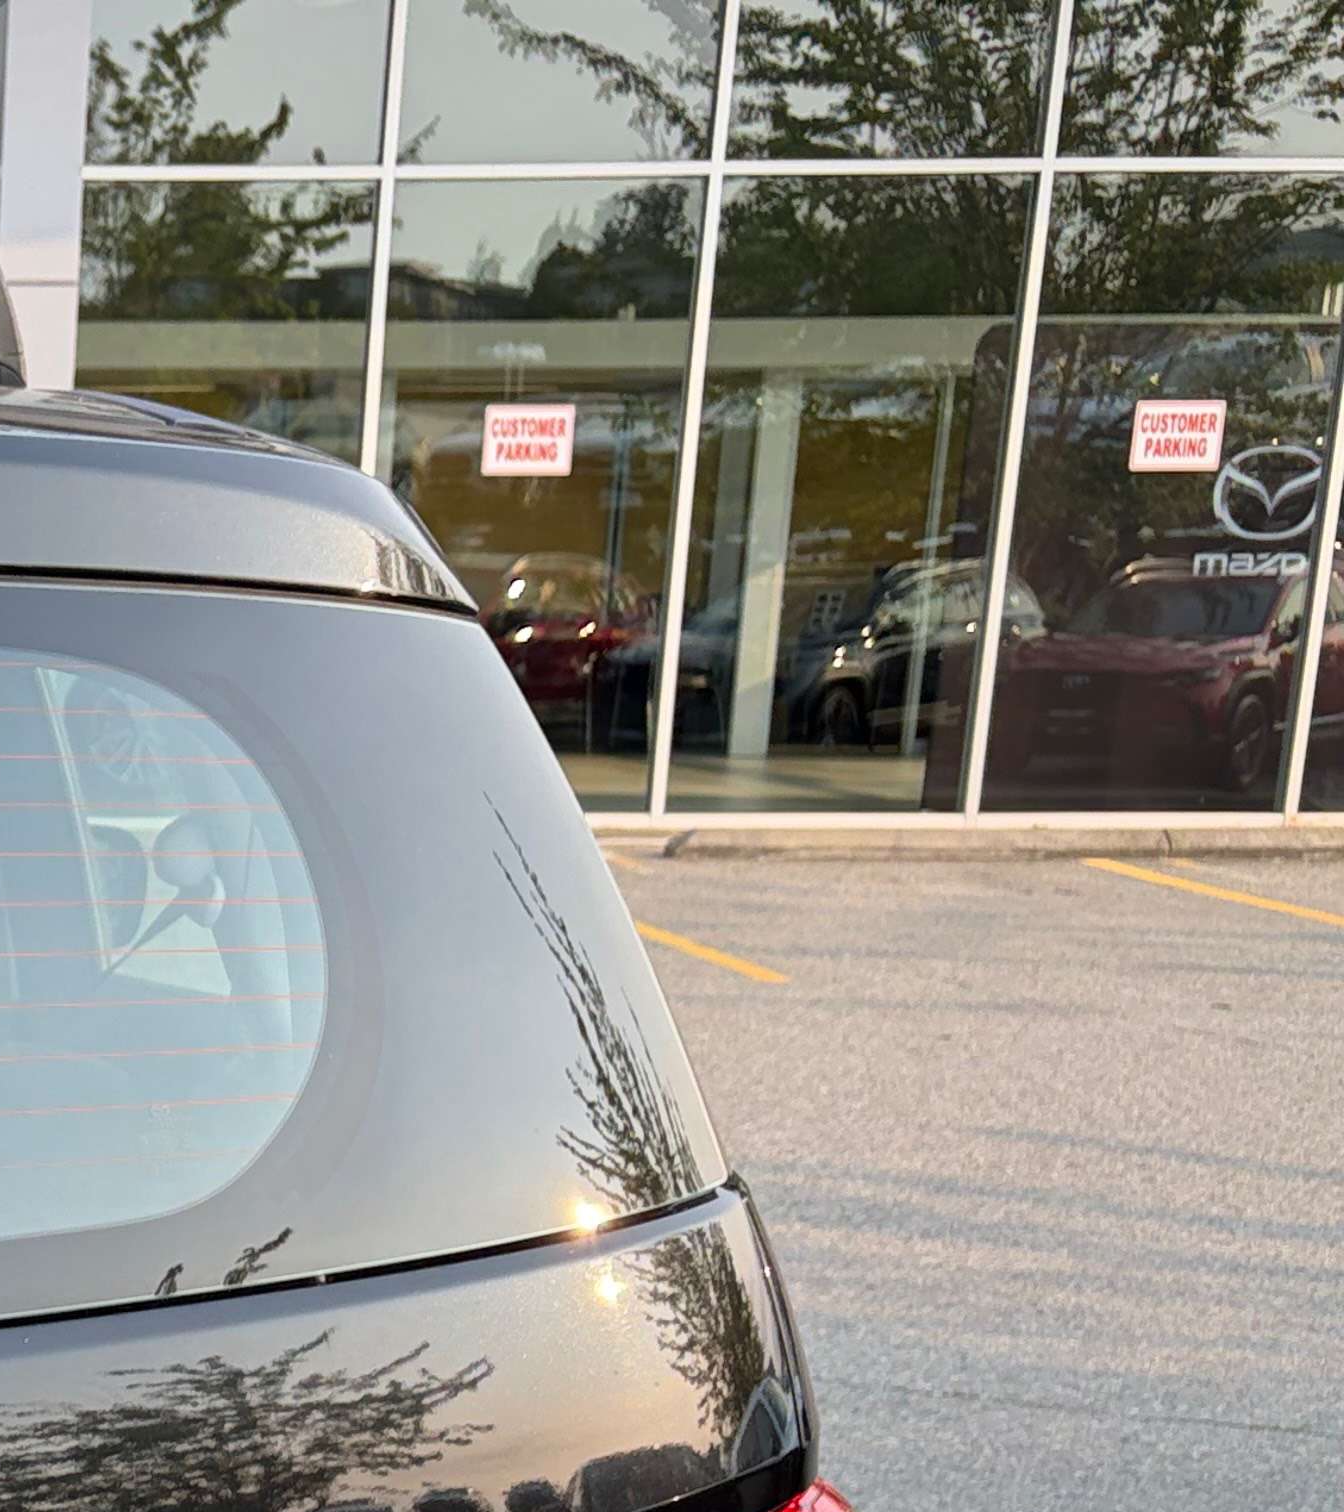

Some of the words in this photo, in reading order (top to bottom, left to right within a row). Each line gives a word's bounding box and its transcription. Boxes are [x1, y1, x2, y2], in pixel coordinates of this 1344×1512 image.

[491, 417, 566, 438] CUSTOMER
[1140, 413, 1218, 434] CUSTOMER
[495, 442, 559, 463] PARKING
[1143, 437, 1208, 458] PARKING
[1192, 552, 1310, 577] mazd
